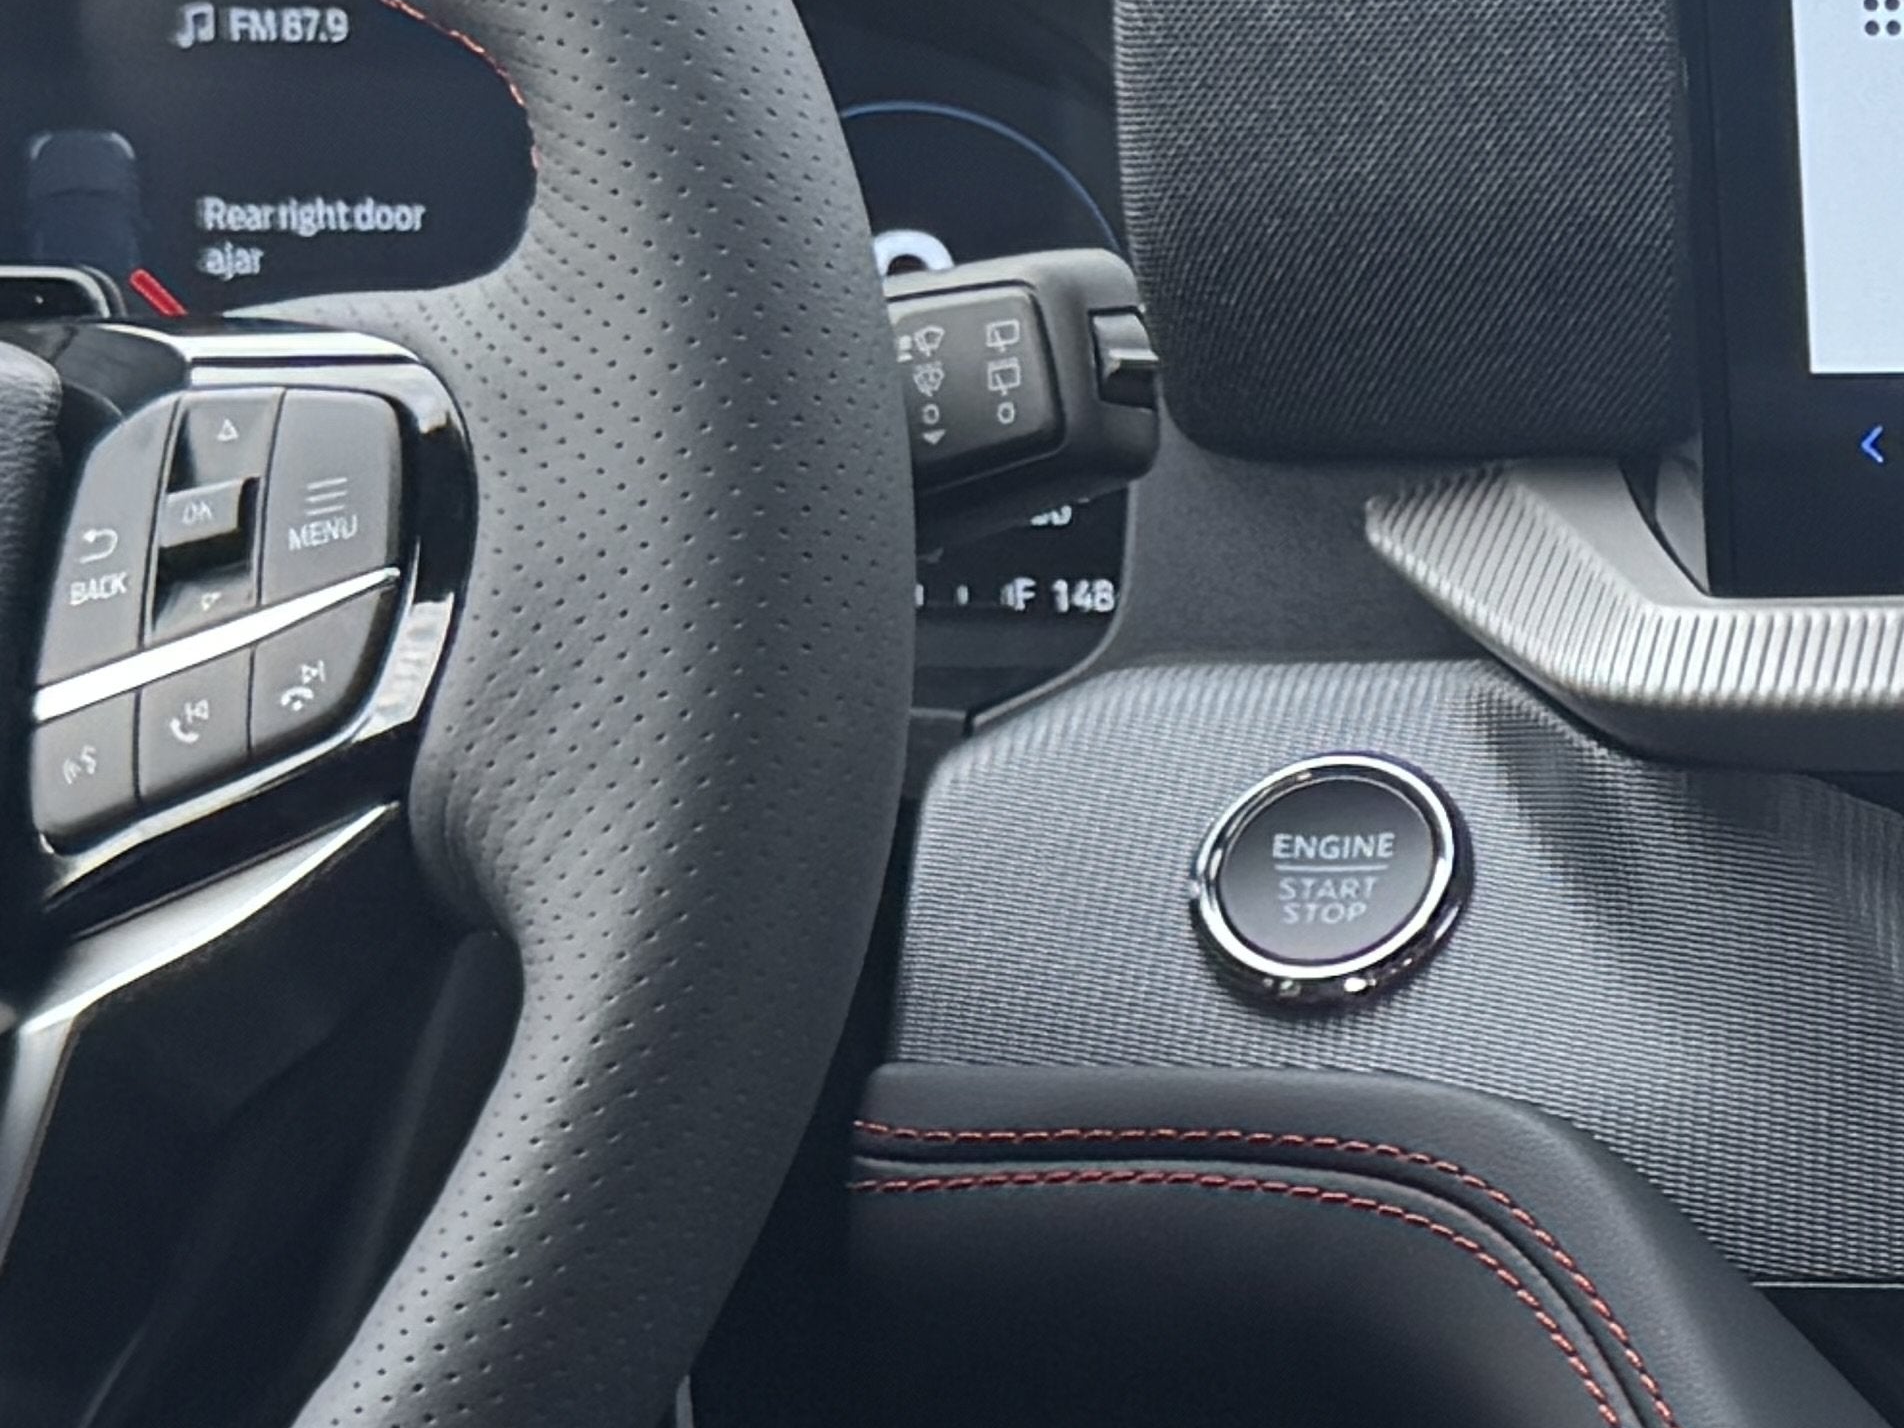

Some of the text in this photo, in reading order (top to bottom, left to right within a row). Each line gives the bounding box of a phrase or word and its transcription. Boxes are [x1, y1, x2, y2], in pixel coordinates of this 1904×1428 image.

[229, 6, 350, 44] FM 87.9
[200, 195, 427, 238] Rear right door
[202, 240, 265, 281] ajar
[286, 515, 359, 551] MENU
[69, 572, 129, 606] BACK
[1272, 832, 1396, 860] ENGINE
[1278, 876, 1379, 901] START
[1282, 902, 1368, 924] STOP
